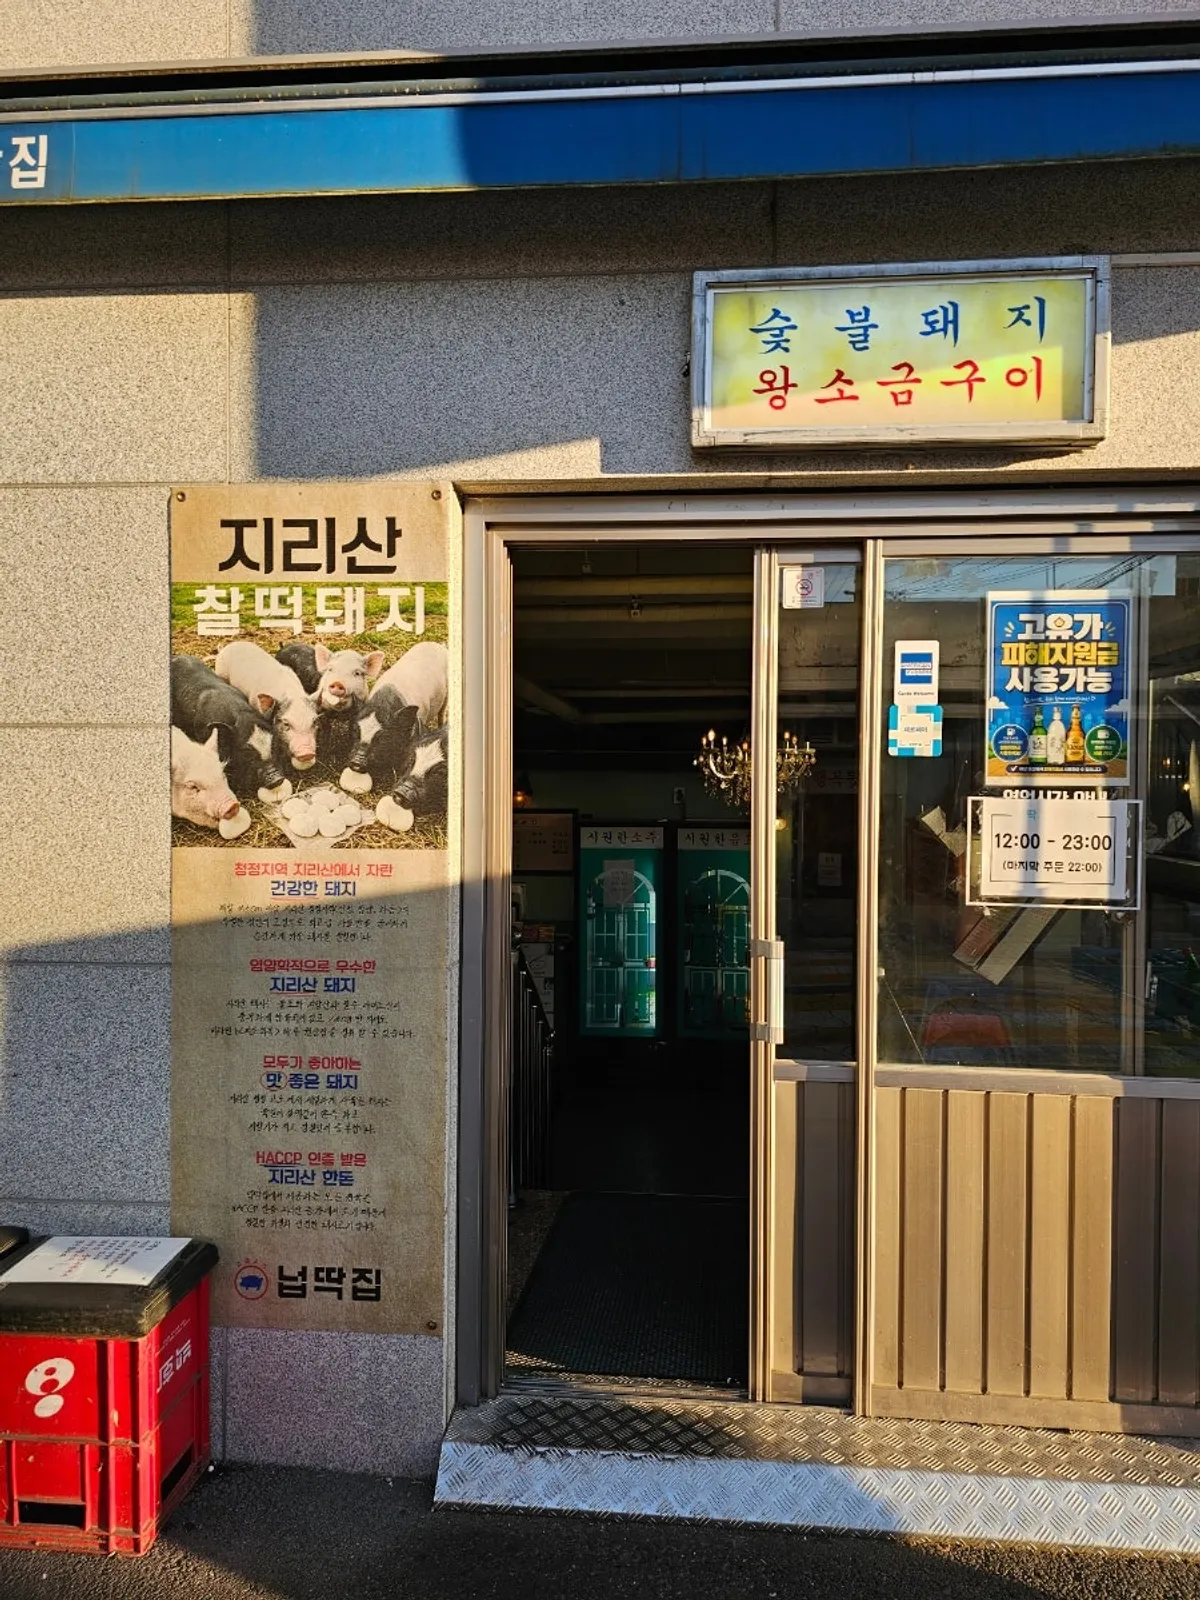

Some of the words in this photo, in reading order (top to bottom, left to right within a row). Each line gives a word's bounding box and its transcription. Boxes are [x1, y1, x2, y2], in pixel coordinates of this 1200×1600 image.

[0, 134, 48, 190] 집
[752, 355, 1043, 411] 왕소금구이
[218, 516, 403, 575] 지리산
[193, 586, 426, 636] 찰떡돼지
[1016, 612, 1104, 640] 고유가
[1001, 641, 1119, 667] 피해지원금
[1004, 667, 1113, 694] 사용가능
[994, 833, 1041, 850] 12:00
[1062, 834, 1113, 851] 23:00
[293, 862, 360, 878] 지리산에서
[367, 862, 393, 878] 자란
[1002, 860, 1040, 873] (마지막
[1043, 860, 1064, 873] 주문
[1067, 861, 1103, 873] 22:00)
[270, 880, 318, 896] 건강한
[324, 881, 357, 897] 돼지
[335, 959, 376, 974] 우수한
[269, 977, 317, 993] 지리산
[323, 977, 356, 994] 돼지
[263, 1055, 303, 1070] 모두가
[308, 1056, 362, 1071] 좋아하는
[266, 1073, 283, 1089] 맛
[287, 1073, 320, 1090] 좋은
[326, 1074, 359, 1090] 돼지
[255, 1151, 303, 1165] HACCP
[307, 1152, 335, 1166] 인증
[340, 1152, 367, 1167] 받은
[268, 1169, 316, 1185] 지리산
[321, 1170, 355, 1187] 한돈
[277, 1264, 382, 1302] 넙딱집
